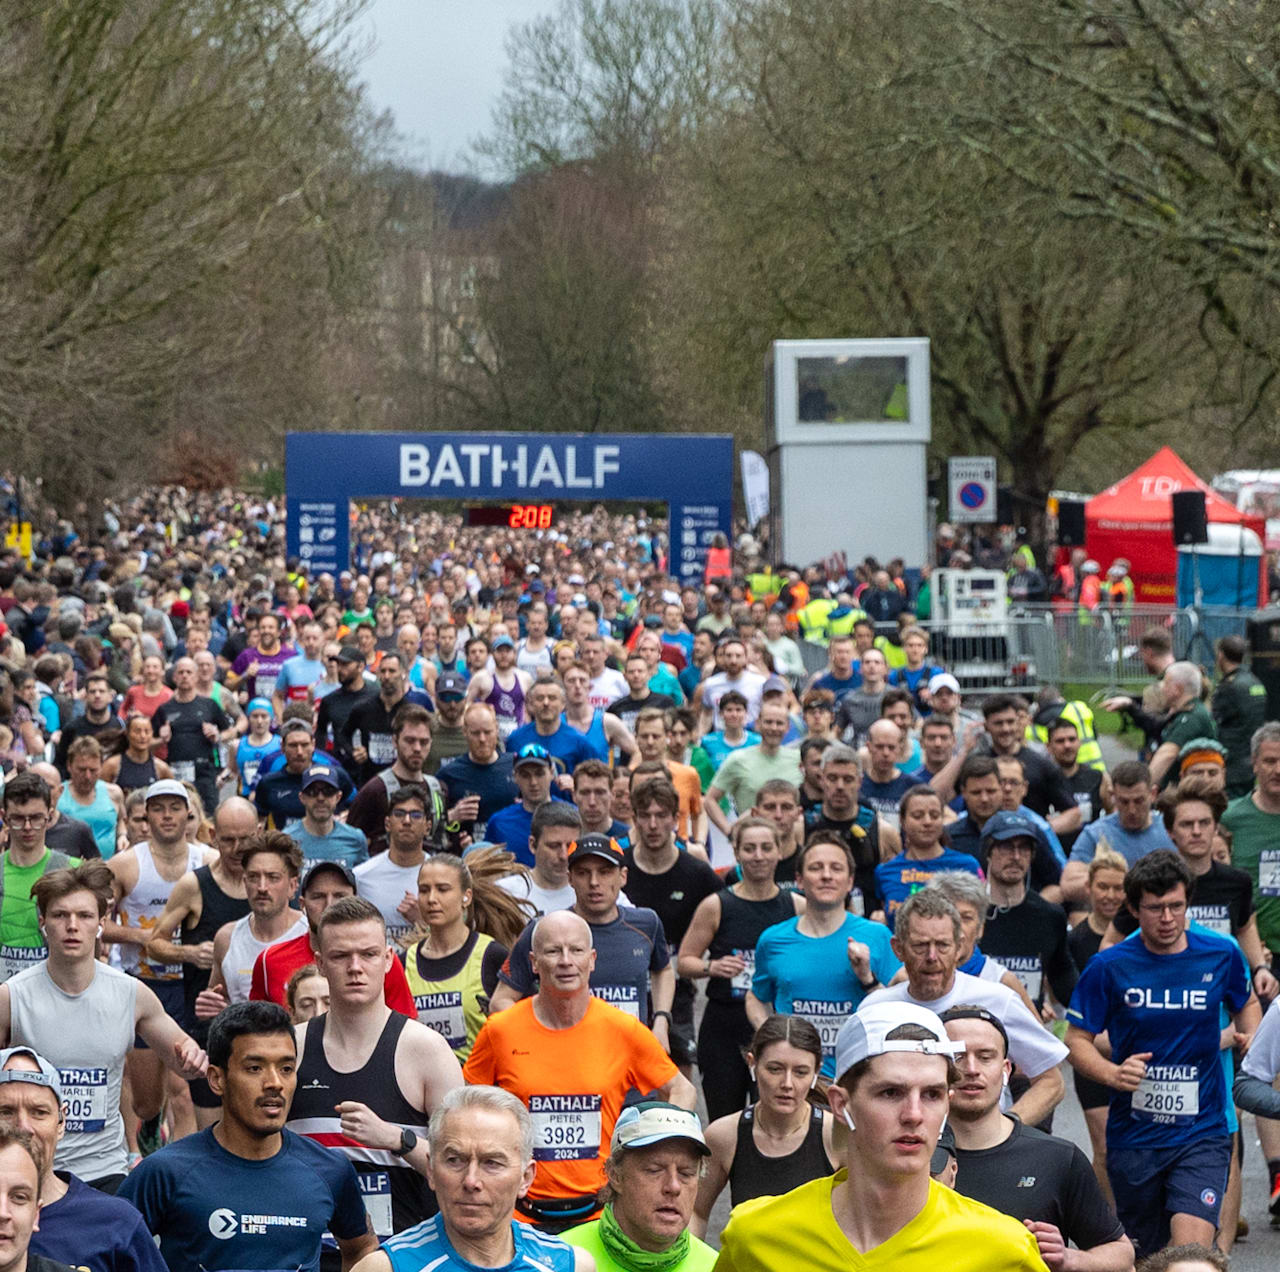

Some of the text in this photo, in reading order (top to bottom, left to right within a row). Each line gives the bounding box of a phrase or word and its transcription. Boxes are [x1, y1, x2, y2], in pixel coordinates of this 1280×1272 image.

[400, 444, 620, 489] BATHALF
[1185, 906, 1228, 919] ATHALF
[1, 945, 48, 959] BATHALF
[589, 986, 637, 1000] ATHALF
[1124, 988, 1207, 1011] OLLIE
[415, 993, 460, 1009] ATHALF
[794, 1000, 852, 1014] BATHALF
[60, 1069, 106, 1085] THALF
[1144, 1066, 1199, 1083] ATHALF
[60, 1088, 96, 1097] HARLIE
[1152, 1083, 1181, 1093] OLLIE
[532, 1096, 599, 1111] BATHALF
[1144, 1093, 1185, 1112] 2805
[549, 1115, 583, 1123] PETER
[1152, 1113, 1176, 1124] 2024
[65, 1121, 85, 1131] 024
[544, 1126, 586, 1145] 3982
[554, 1149, 580, 1160] 2024
[241, 1215, 307, 1227] ENDURANCE
[241, 1224, 267, 1235] LIFE
